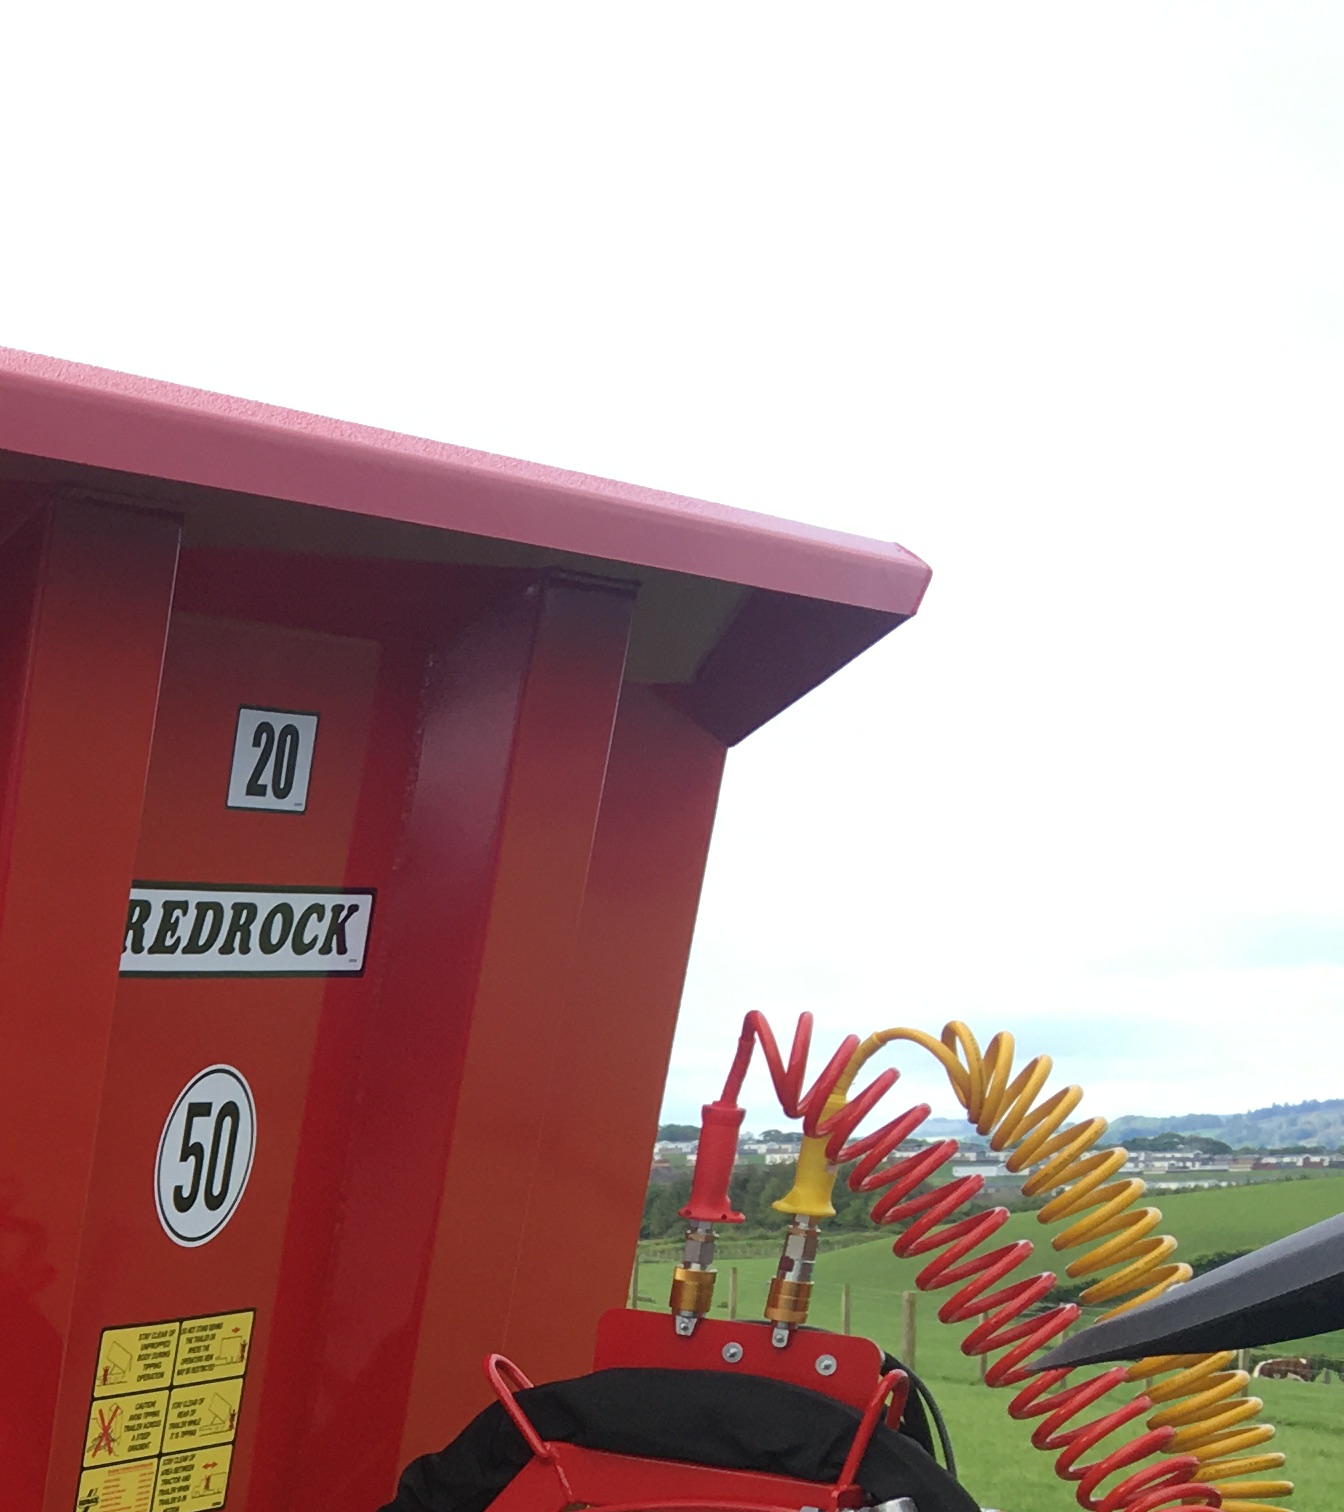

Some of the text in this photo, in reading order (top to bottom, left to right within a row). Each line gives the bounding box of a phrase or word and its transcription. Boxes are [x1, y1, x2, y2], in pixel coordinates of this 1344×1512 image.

[245, 721, 300, 800] 20
[121, 898, 360, 956] REDROCK
[173, 1100, 240, 1213] 50
